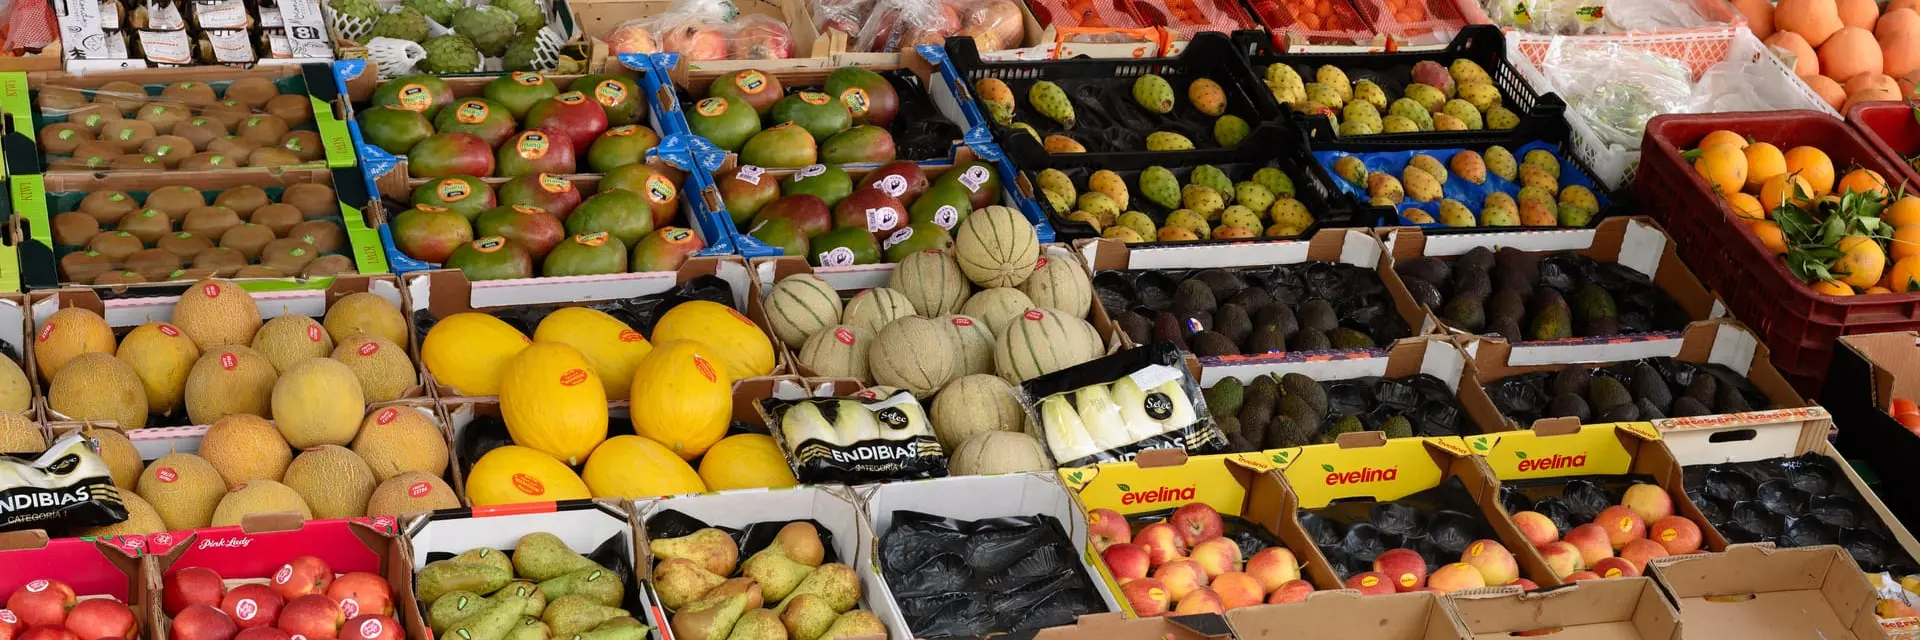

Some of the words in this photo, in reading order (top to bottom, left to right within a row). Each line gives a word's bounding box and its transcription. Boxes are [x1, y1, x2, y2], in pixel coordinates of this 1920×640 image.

[20, 182, 33, 201] KIWI
[367, 246, 380, 264] KIWI
[831, 442, 917, 462] ENDIBIAS
[1238, 457, 1268, 469] evelina
[1517, 454, 1587, 472] evelina
[1325, 467, 1397, 485] evelina
[0, 486, 89, 513] NDIBIAS
[1121, 486, 1196, 505] evelina
[198, 537, 225, 550] Pink
[225, 536, 251, 548] Lady
